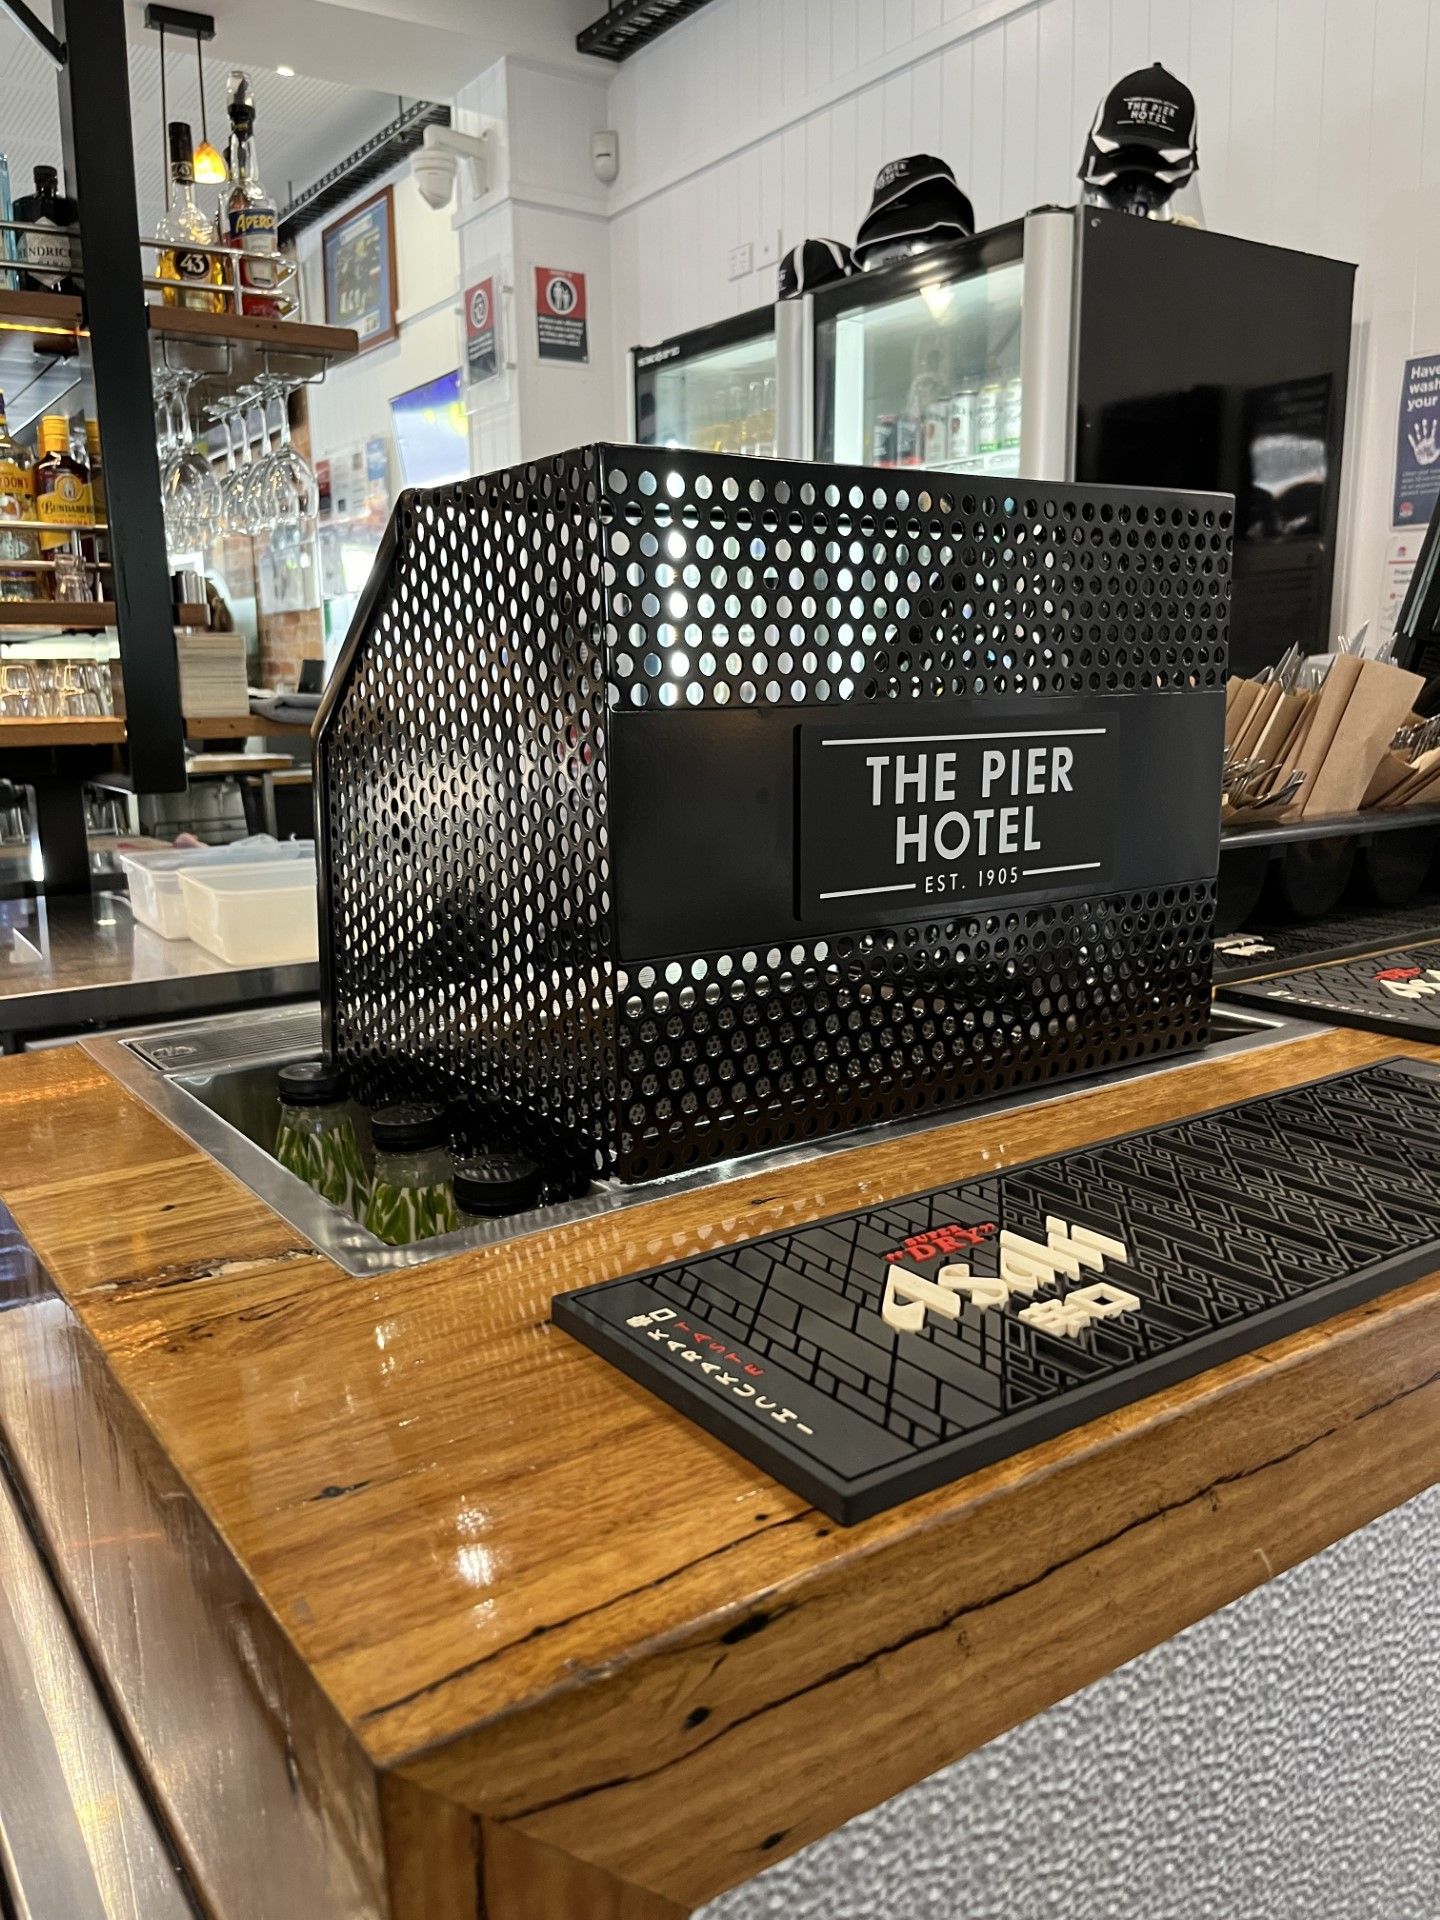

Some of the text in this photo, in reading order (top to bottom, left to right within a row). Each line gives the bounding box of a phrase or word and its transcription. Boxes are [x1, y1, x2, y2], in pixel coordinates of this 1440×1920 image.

[1127, 102, 1175, 117] THE PIER
[1130, 110, 1167, 124] HOTEL
[236, 214, 274, 233] APERO
[180, 253, 205, 273] 43
[1411, 365, 1440, 379] Have
[1407, 396, 1438, 412] your
[866, 746, 1074, 806] THE PIER
[895, 805, 1041, 865] HOTEL
[925, 866, 1018, 893] EST. 1905
[674, 1320, 765, 1377] TASTE
[647, 1328, 814, 1435] KARAKUCHI
